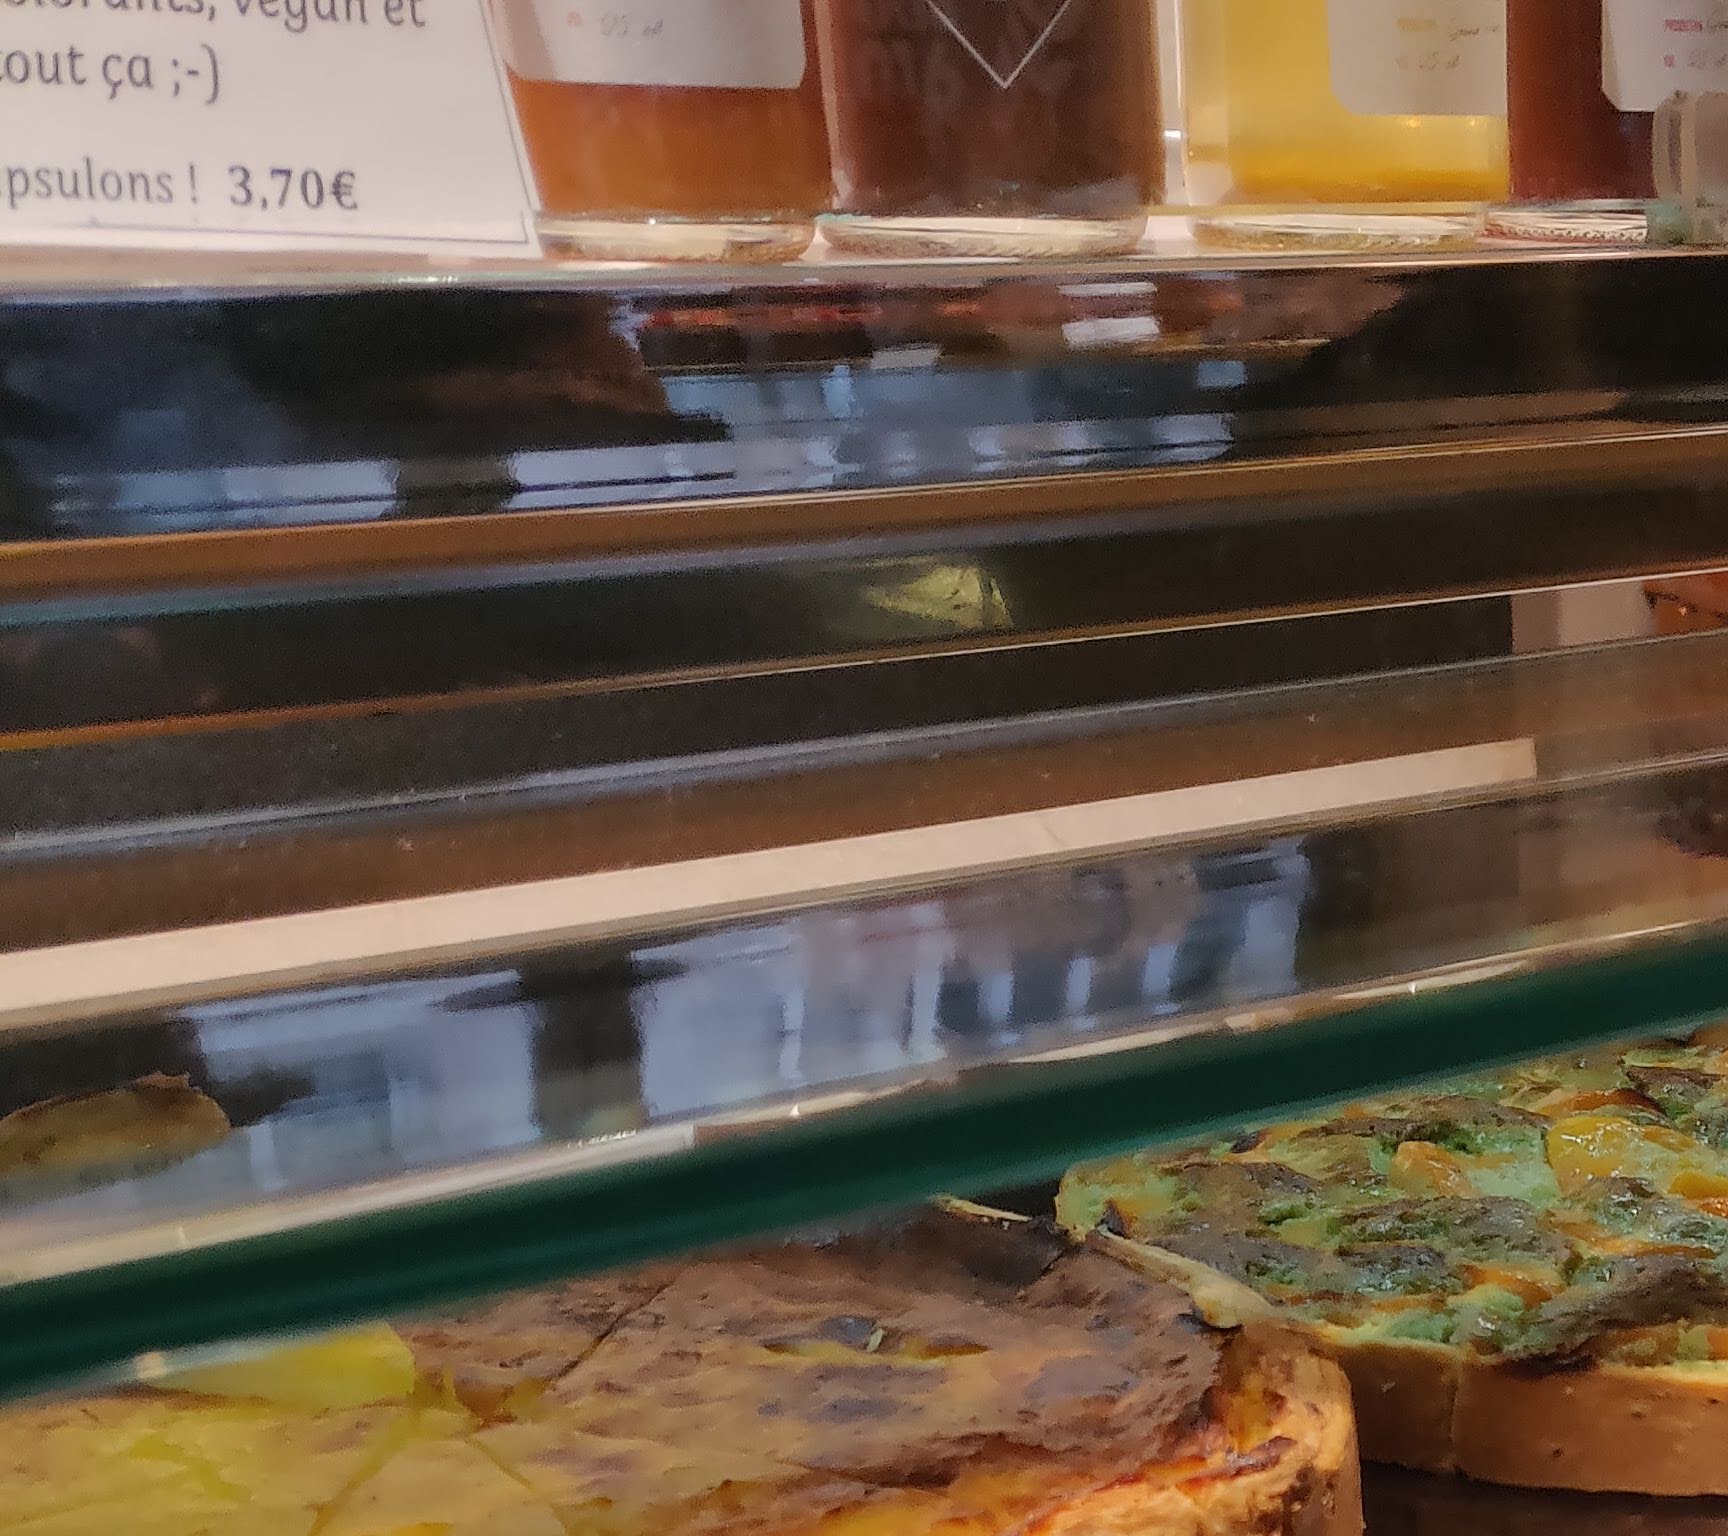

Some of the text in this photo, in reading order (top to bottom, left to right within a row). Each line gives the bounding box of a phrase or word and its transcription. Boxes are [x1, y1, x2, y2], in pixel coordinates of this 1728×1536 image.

[0, 44, 88, 85] out
[102, 53, 154, 100] ça
[0, 155, 174, 210] psulons
[227, 165, 359, 211] 3,70€
